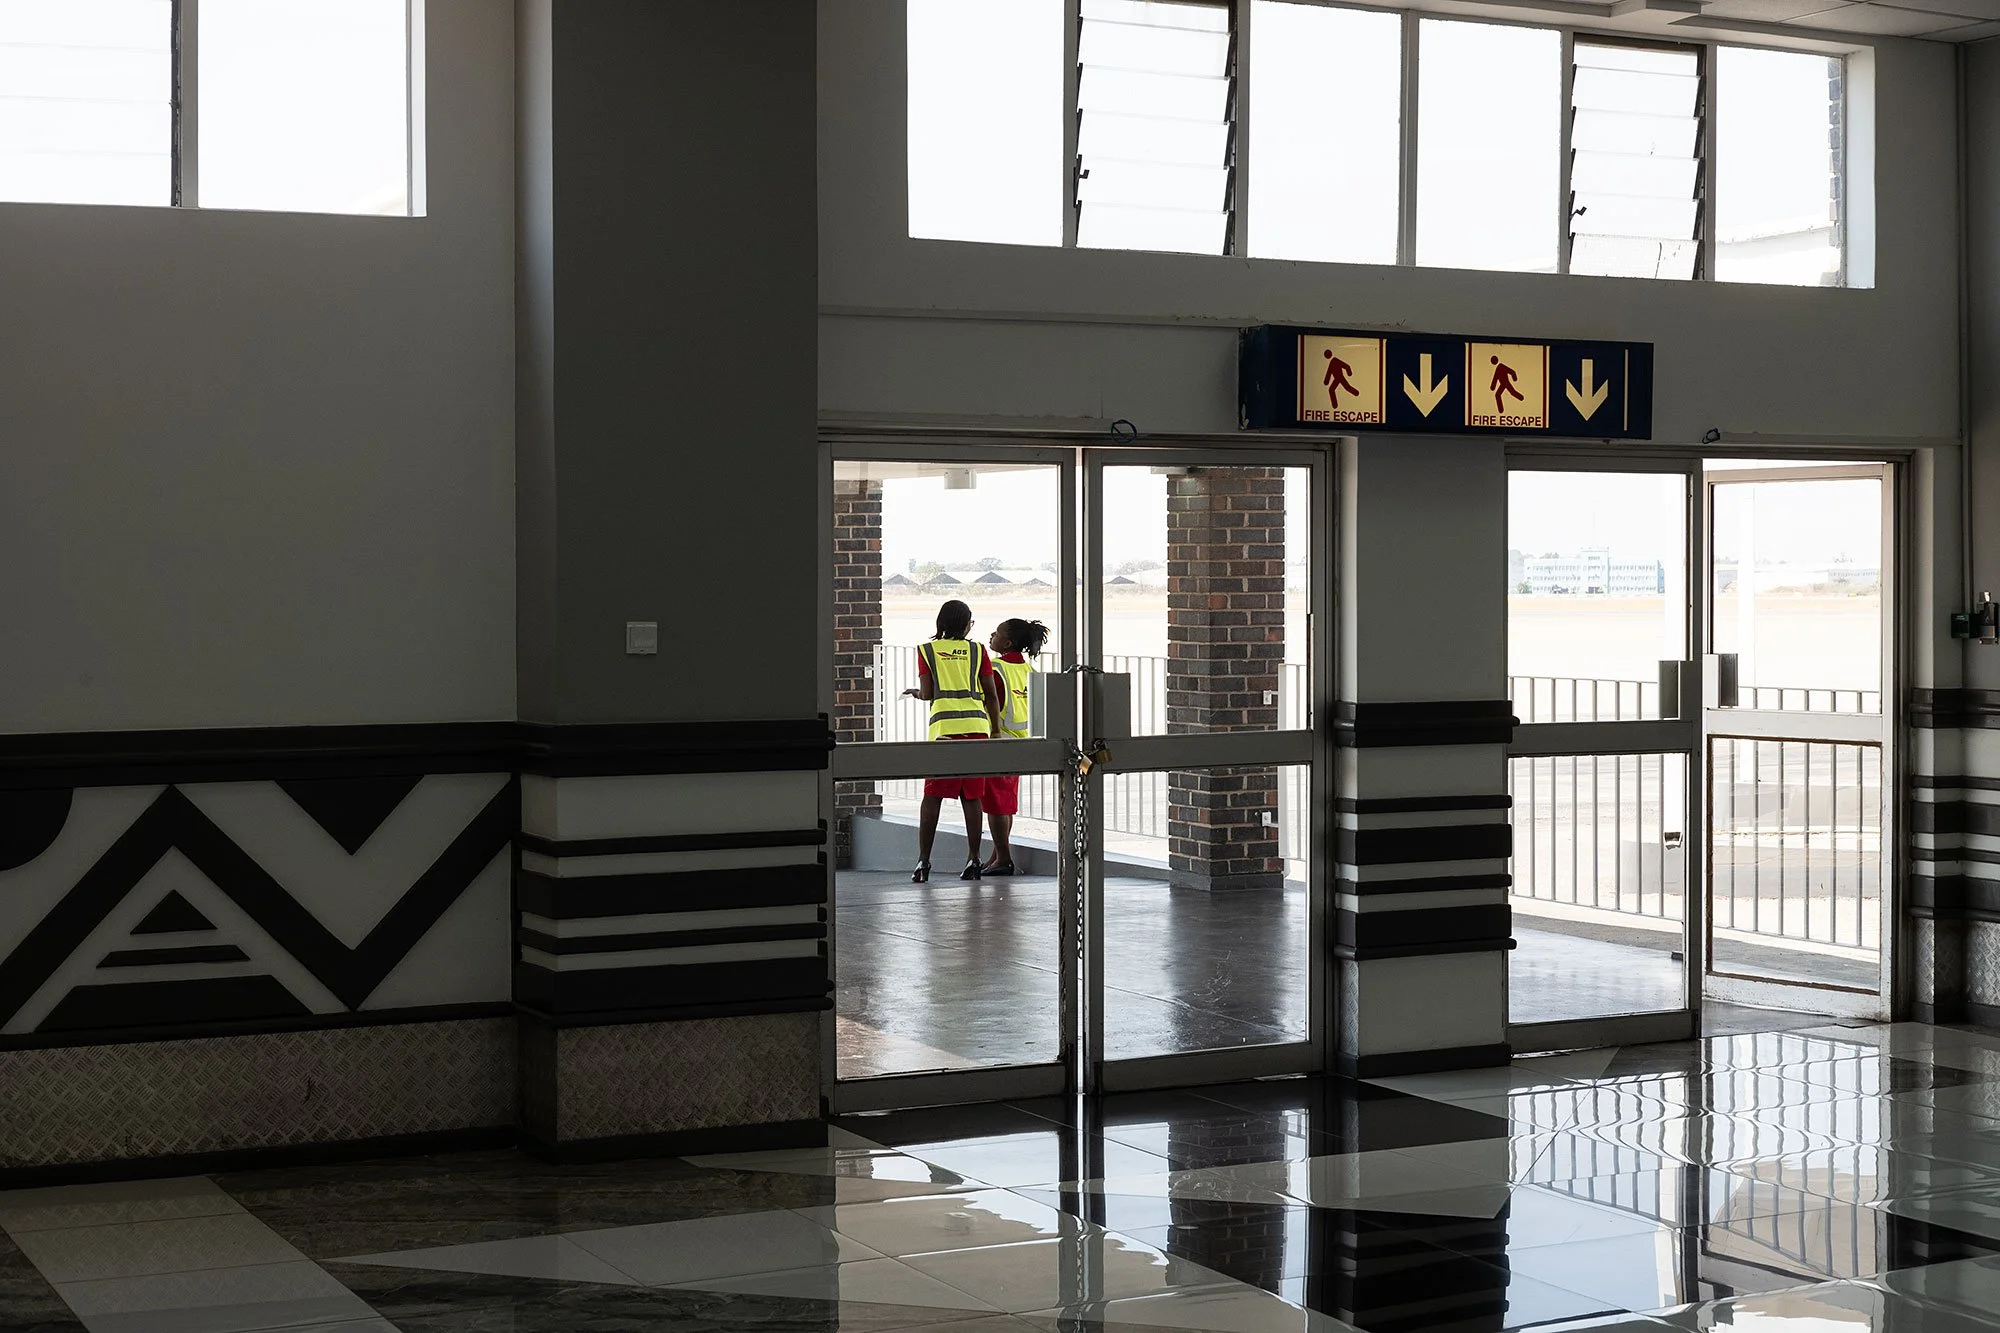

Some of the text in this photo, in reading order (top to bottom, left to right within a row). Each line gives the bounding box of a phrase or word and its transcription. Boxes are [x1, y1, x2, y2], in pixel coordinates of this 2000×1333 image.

[1305, 410, 1378, 422] FIRE ESCAPE
[1473, 415, 1542, 427] FIRE ESCAPE
